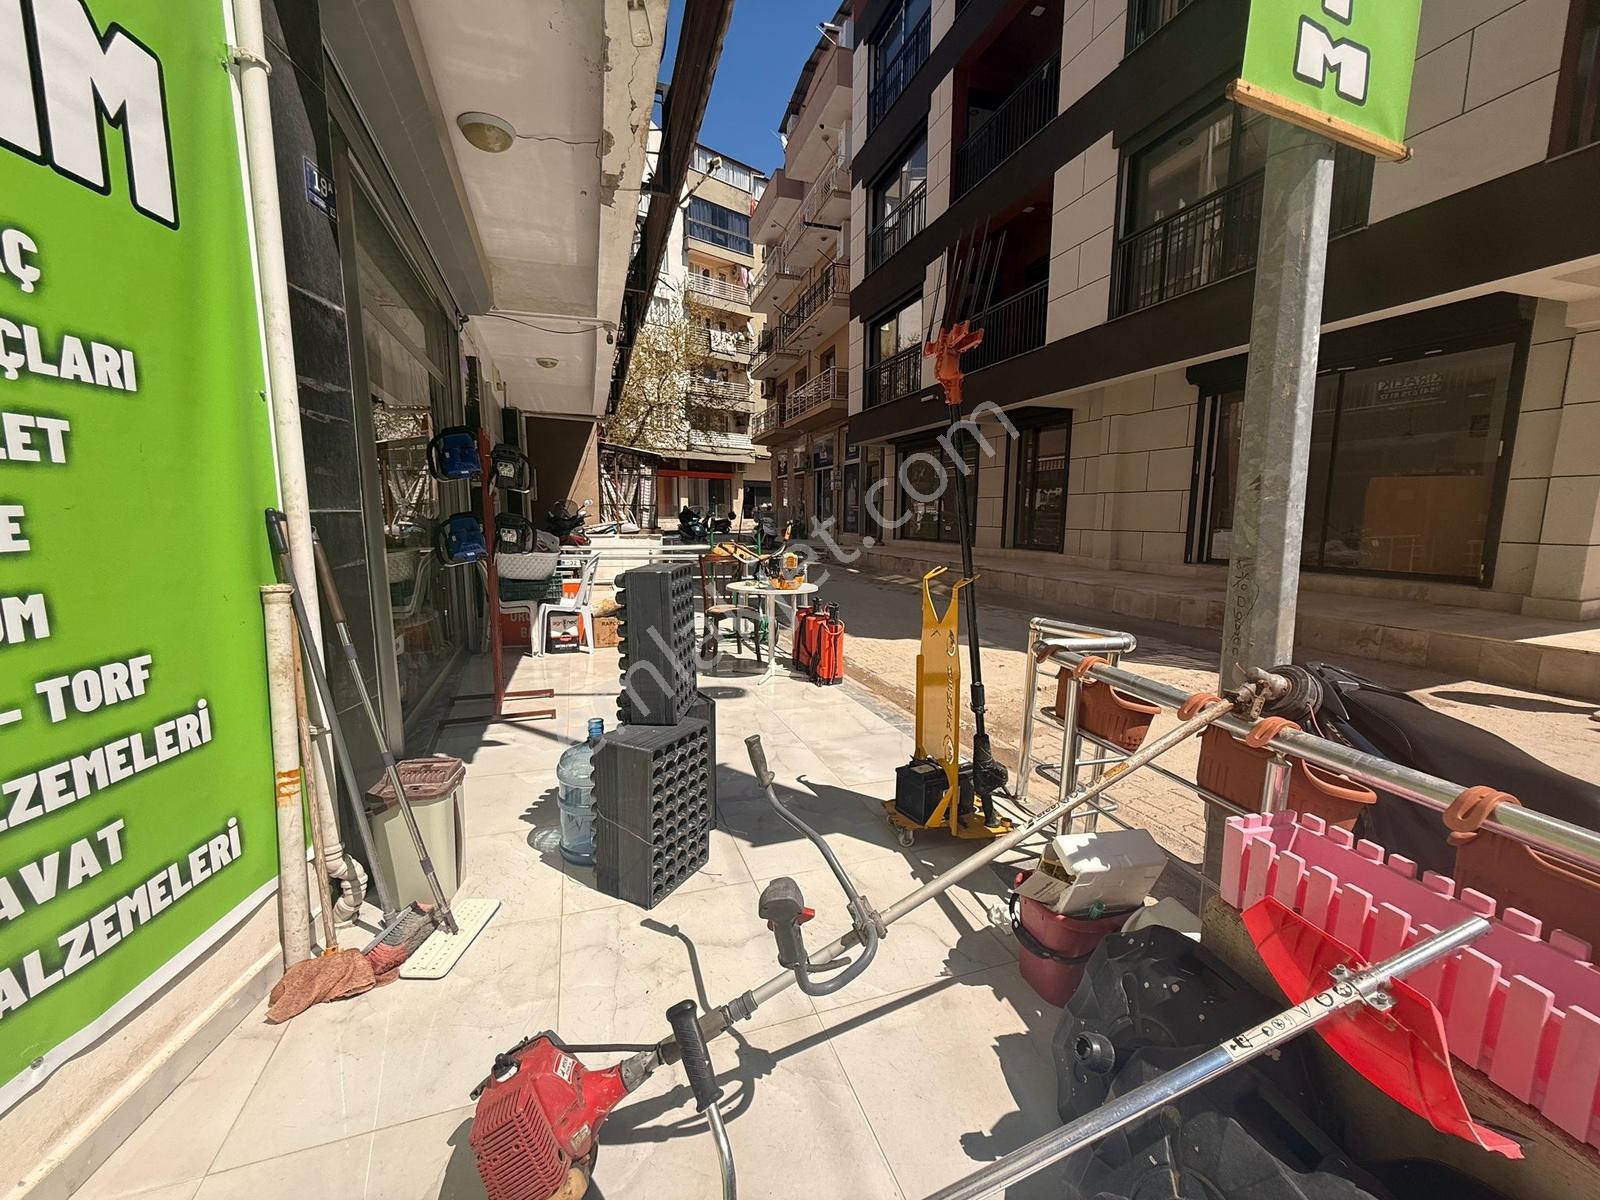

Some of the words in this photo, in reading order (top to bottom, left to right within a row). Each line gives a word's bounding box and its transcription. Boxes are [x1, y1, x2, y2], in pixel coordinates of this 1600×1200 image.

[1293, 0, 1371, 107] M
[0, 0, 180, 231] M
[0, 228, 41, 293] Ç
[0, 412, 71, 464] ET
[0, 593, 51, 644] M
[35, 654, 152, 723] TORF
[0, 698, 212, 832] ZEMELERİ
